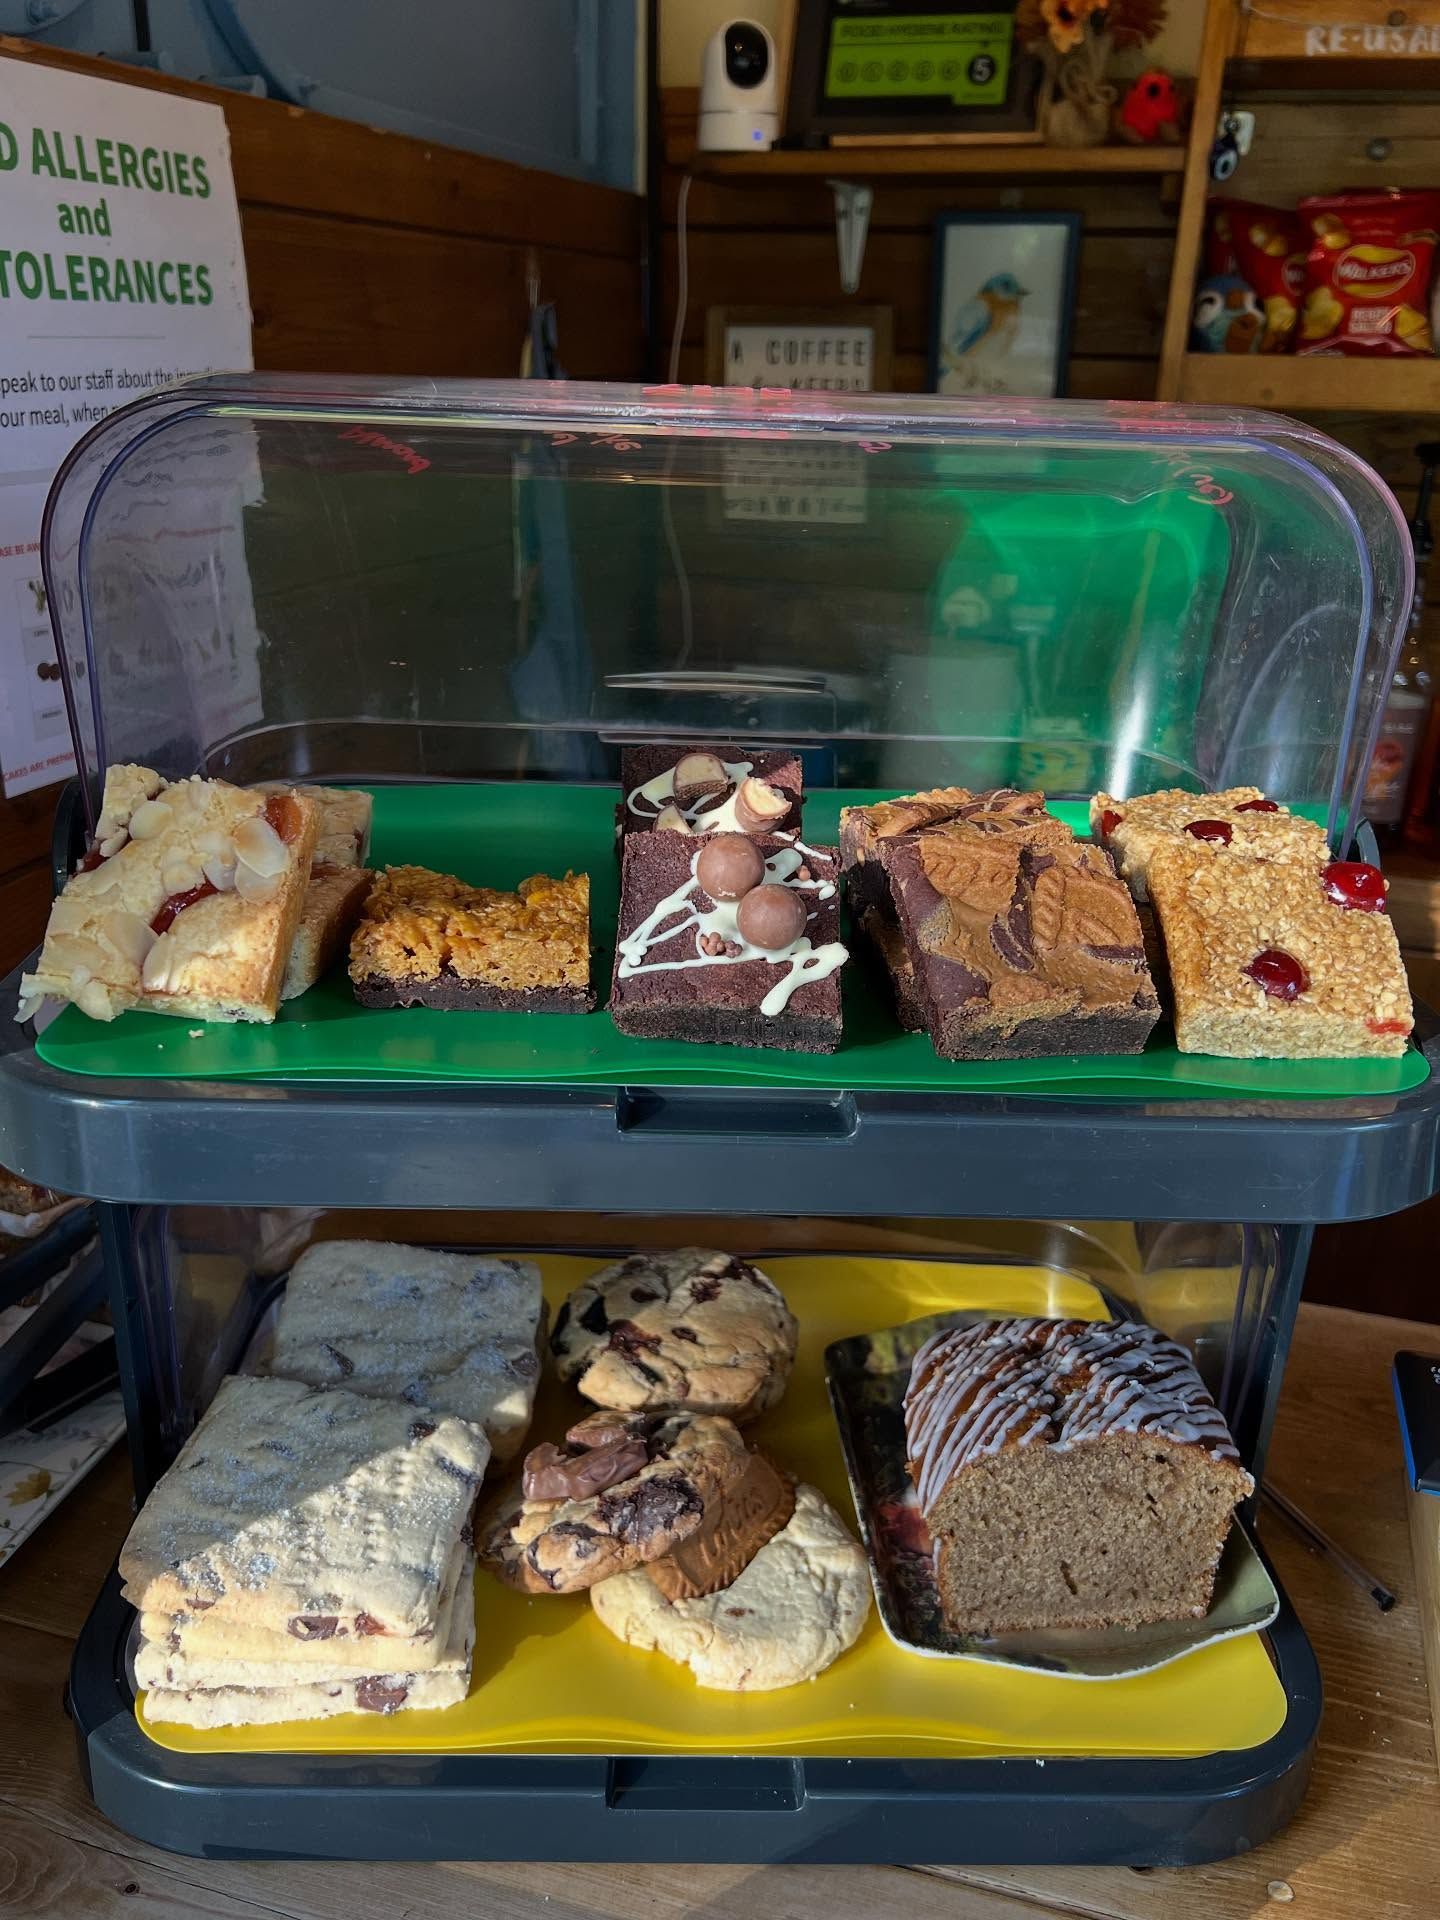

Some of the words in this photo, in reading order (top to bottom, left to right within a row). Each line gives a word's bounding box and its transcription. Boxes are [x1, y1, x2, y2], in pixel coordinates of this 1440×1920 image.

[32, 127, 211, 199] ALLERGIES
[58, 198, 112, 237] and
[0, 250, 214, 306] TOLERANCES
[732, 338, 744, 364] A
[766, 337, 866, 367] COFFEE
[0, 373, 38, 399] peak
[41, 375, 56, 391] to
[59, 374, 84, 391] our
[85, 368, 114, 389] staff
[117, 370, 153, 389] about
[1, 410, 26, 428] our
[30, 405, 70, 427] meal,
[73, 401, 108, 424] when
